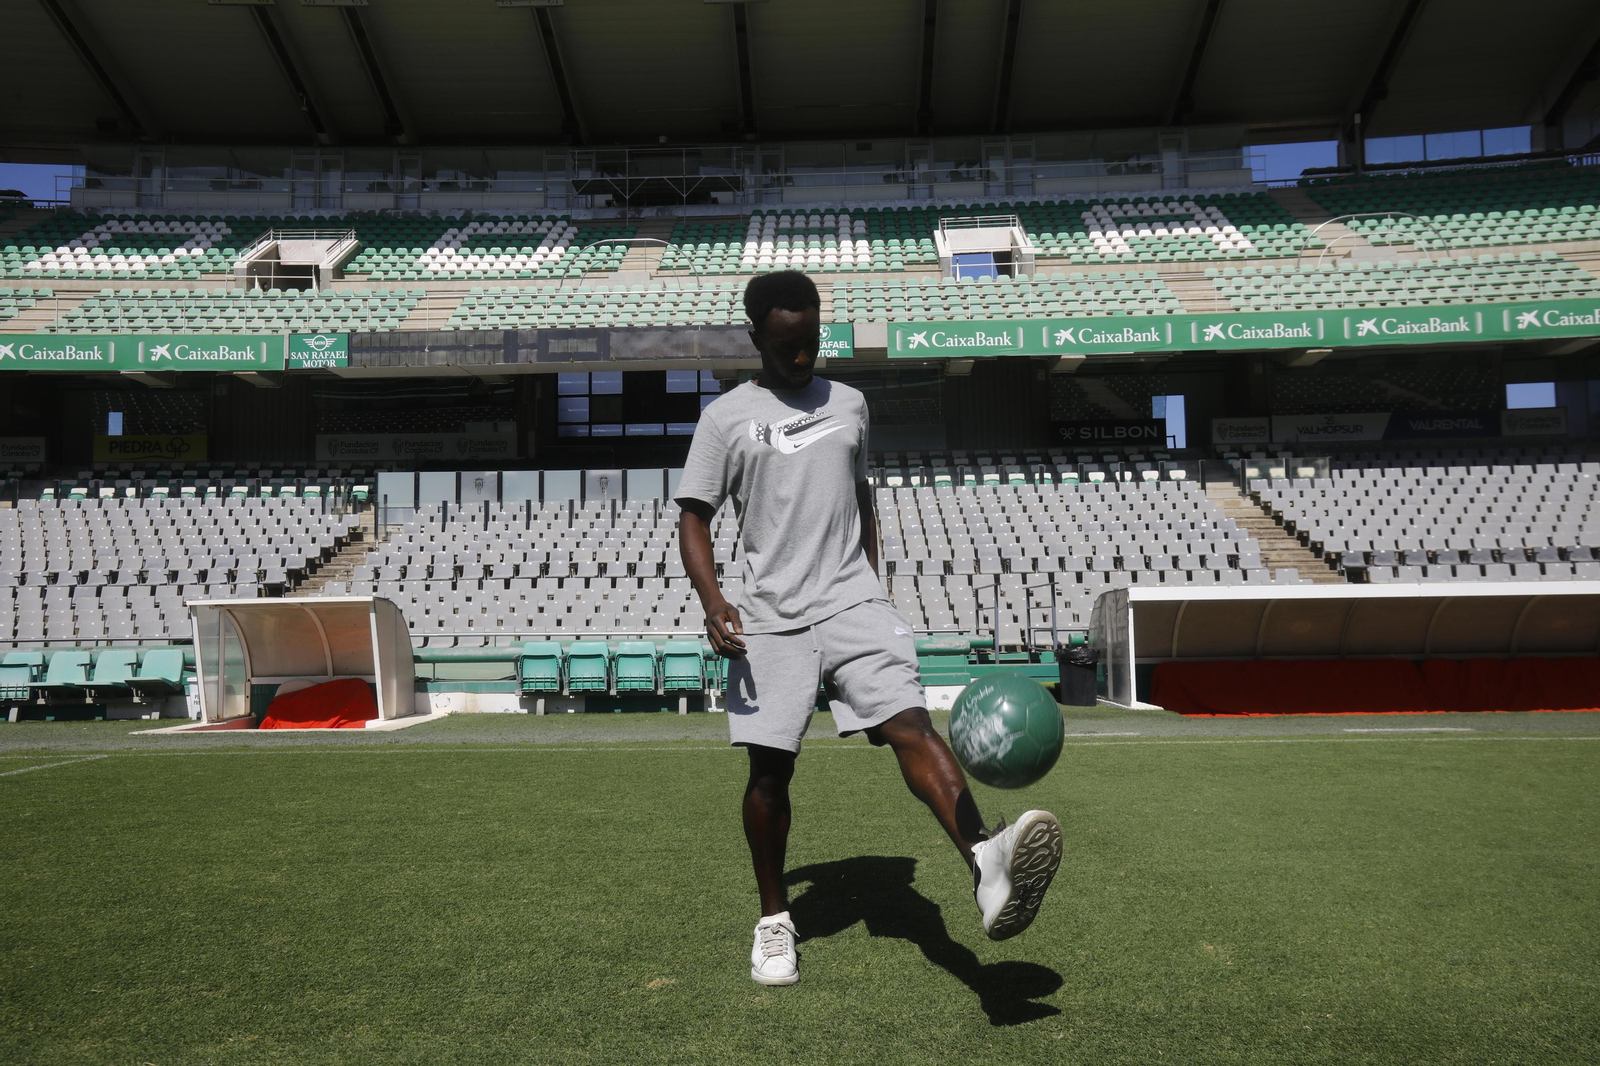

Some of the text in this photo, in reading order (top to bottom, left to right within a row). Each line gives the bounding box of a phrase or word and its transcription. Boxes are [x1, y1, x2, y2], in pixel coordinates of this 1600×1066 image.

[1228, 322, 1312, 339] CaixaBank
[1381, 316, 1471, 334] CaixaBank
[931, 331, 1013, 347] CaixaBank
[1078, 327, 1161, 344] CaixaBank
[19, 344, 103, 360] CaixaBank
[174, 344, 256, 360] CaixaBank
[291, 350, 348, 360] SAN RAFAEL
[302, 359, 337, 368] MOTOR
[1228, 424, 1266, 432] Fundación
[1297, 424, 1364, 435] VALMOPSUR
[1409, 418, 1484, 431] VALRENTAL
[1080, 426, 1157, 439] SILBON
[340, 440, 379, 448] Fundación
[340, 447, 368, 455] Córdoba
